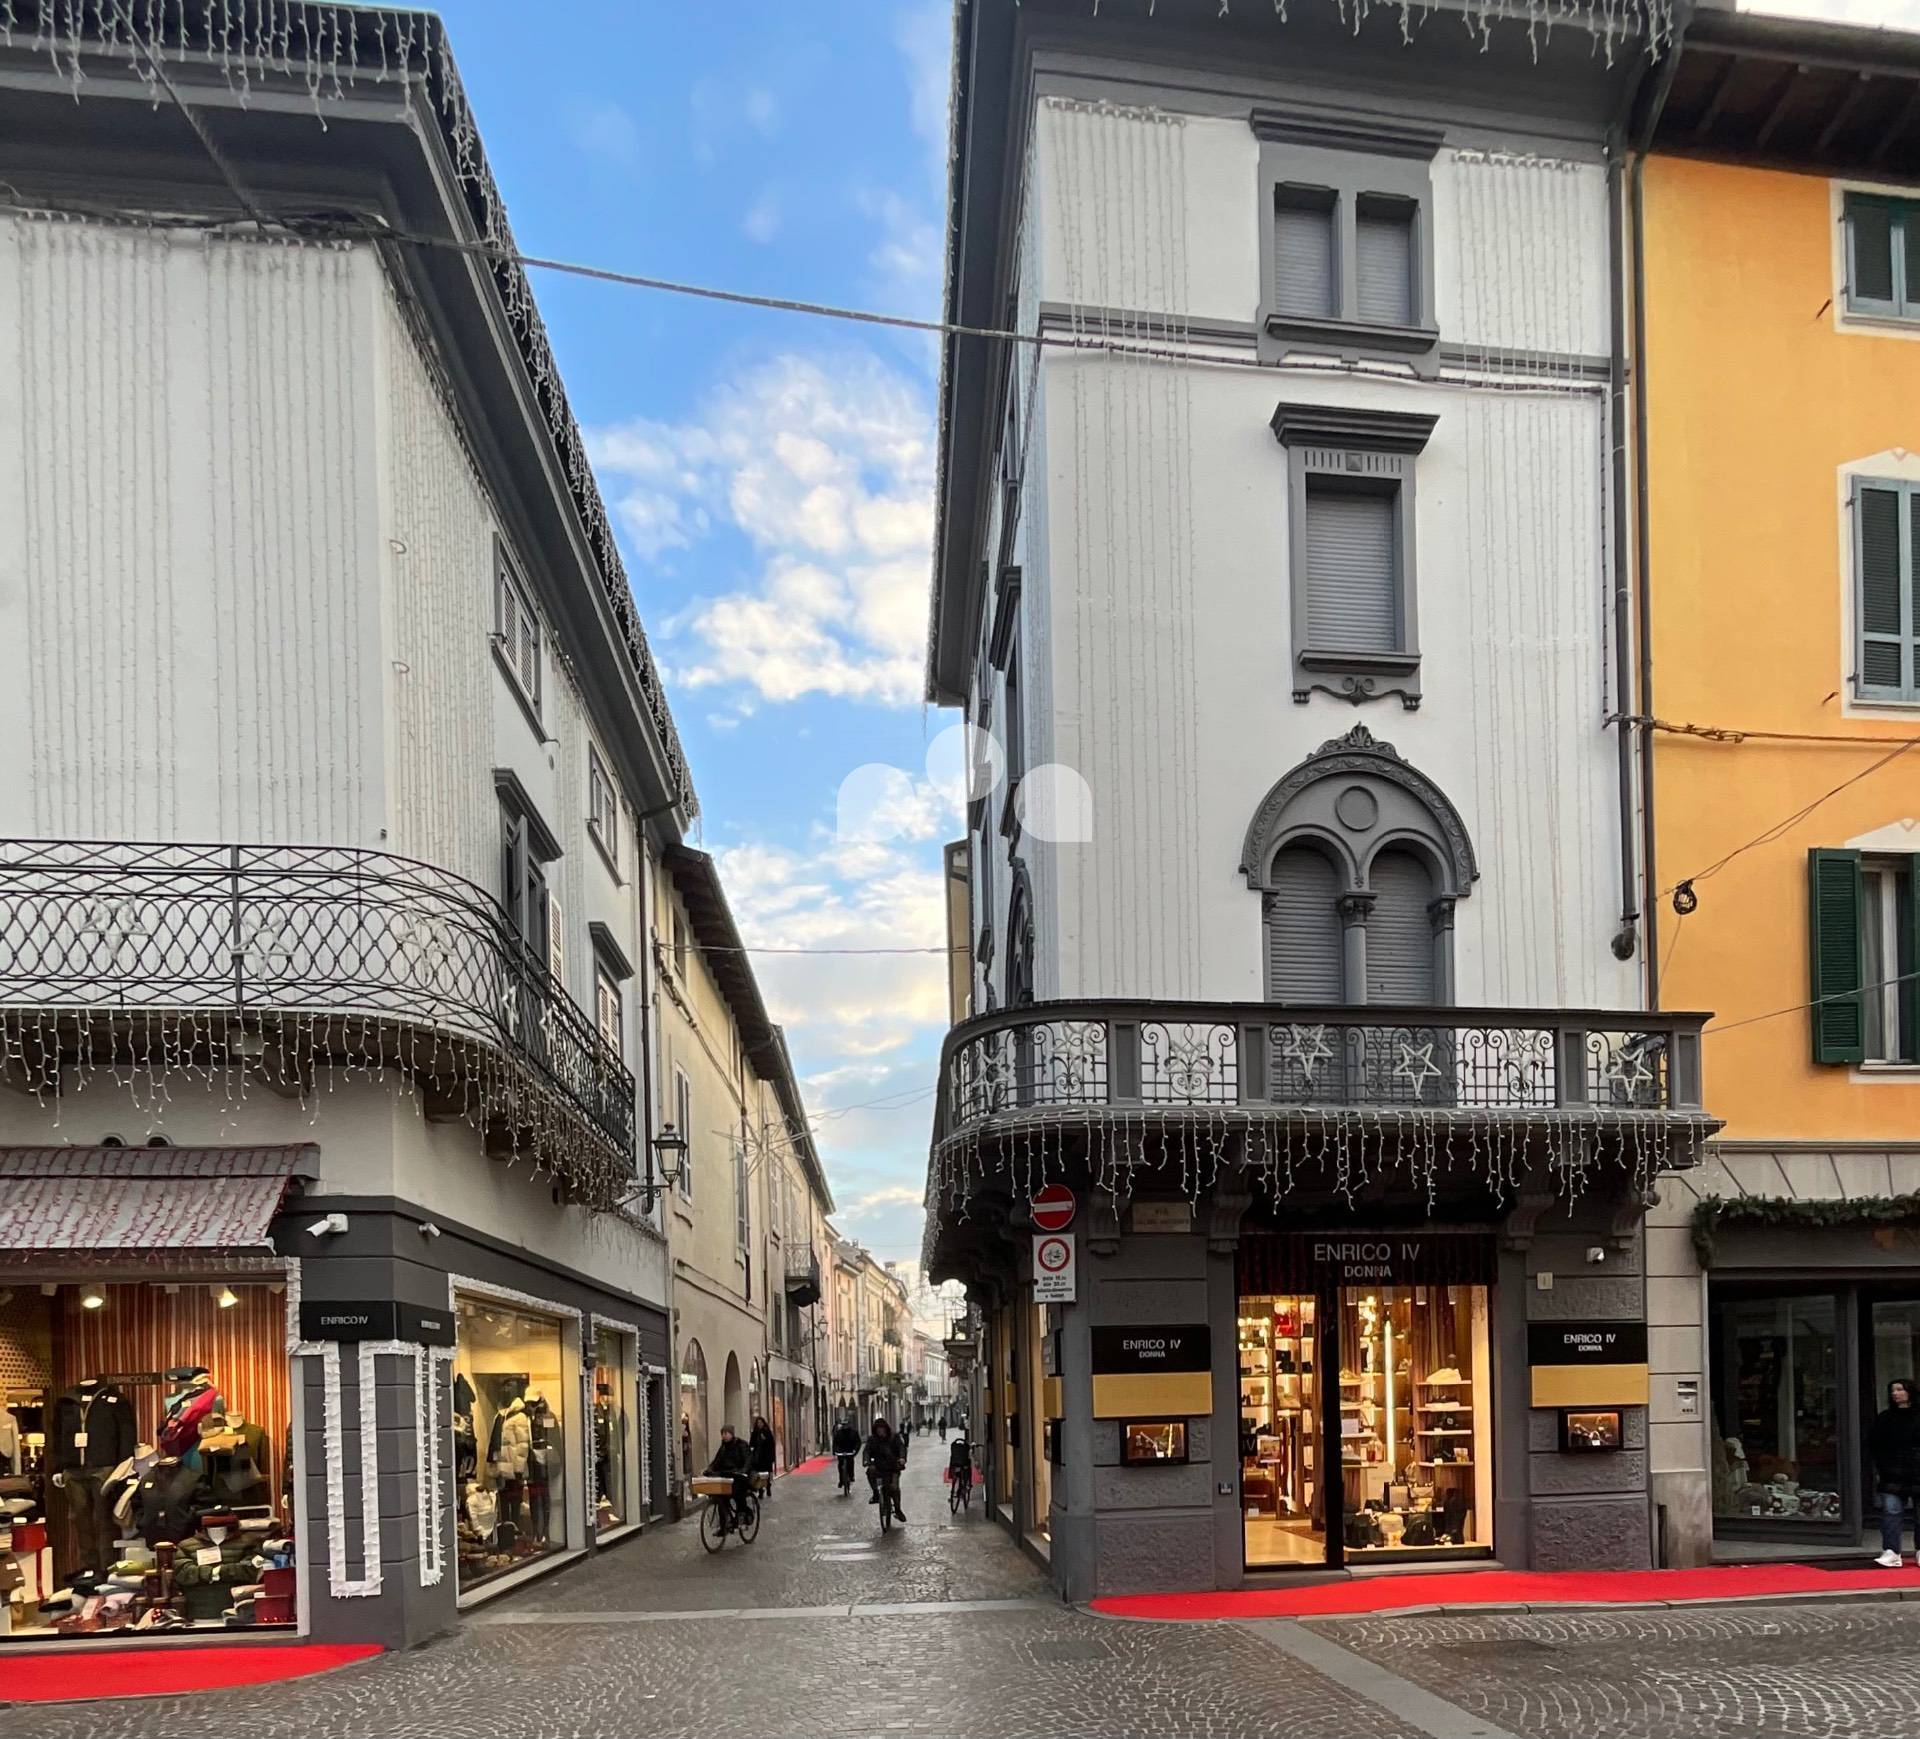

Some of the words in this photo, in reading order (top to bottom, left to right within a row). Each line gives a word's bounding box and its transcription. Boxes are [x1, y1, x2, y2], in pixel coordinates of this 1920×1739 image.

[1314, 1243, 1391, 1261] ENRICO
[1402, 1243, 1420, 1261] IV
[1344, 1265, 1392, 1278] DONNA
[320, 1316, 358, 1326] ENRICO
[358, 1315, 369, 1325] IV
[1123, 1338, 1166, 1350] ENRICO
[1170, 1338, 1181, 1350] IV
[1563, 1333, 1602, 1344] ENRICO
[1606, 1333, 1616, 1344] IV
[1138, 1350, 1166, 1359] DONNA
